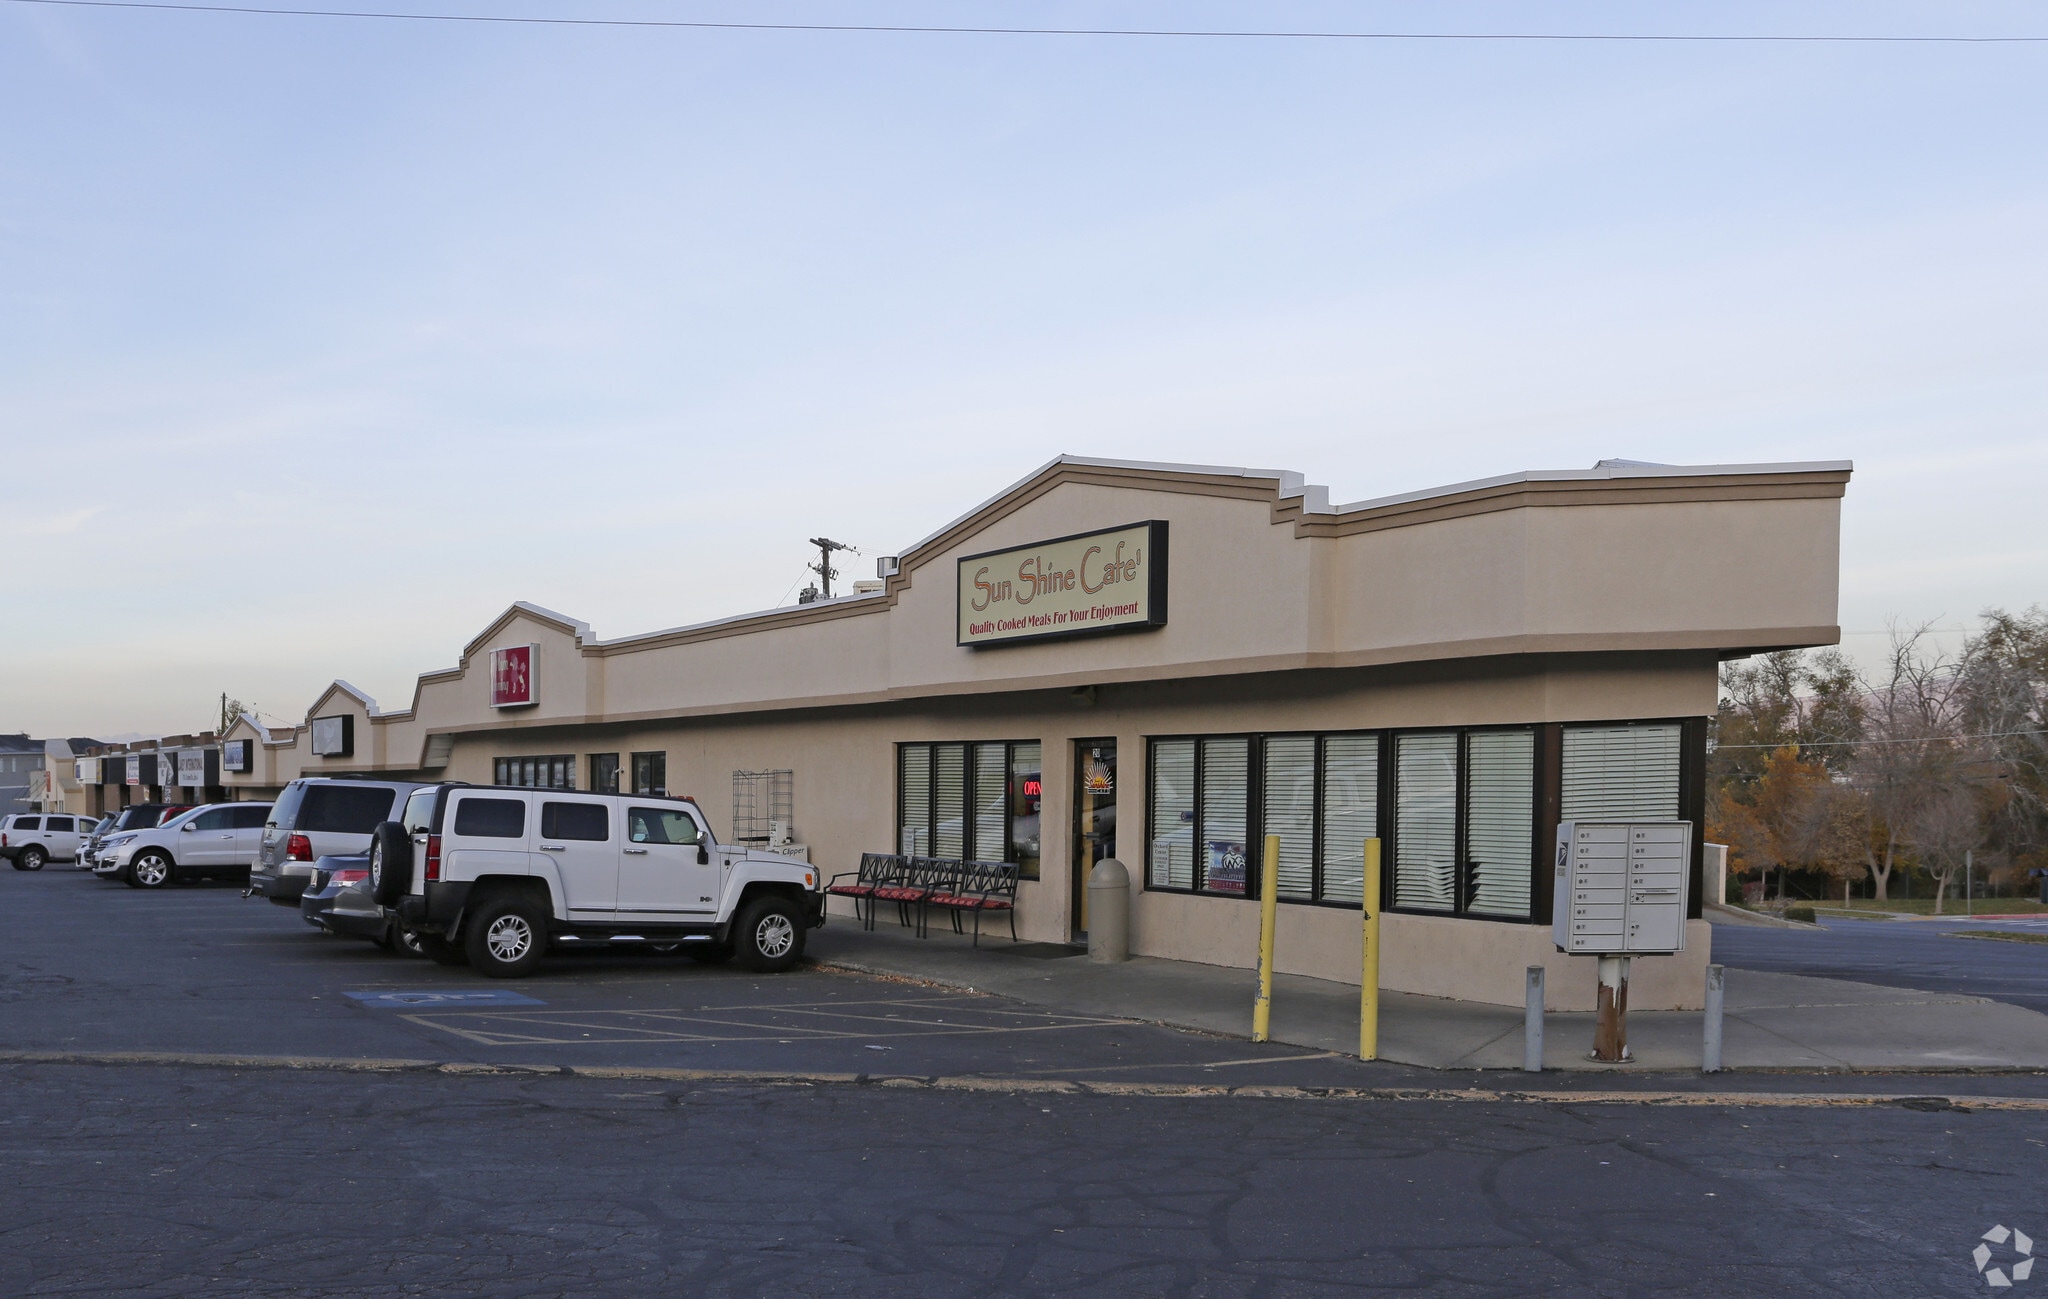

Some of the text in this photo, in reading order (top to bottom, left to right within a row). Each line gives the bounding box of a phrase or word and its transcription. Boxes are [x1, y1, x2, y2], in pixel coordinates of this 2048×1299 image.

[971, 566, 1012, 611] Sun
[1016, 556, 1076, 605] Shine
[969, 601, 1138, 636] Quality Cooked Meals For Your Enjoyment
[1024, 781, 1041, 796] OPEN
[782, 848, 804, 856] Clipper
